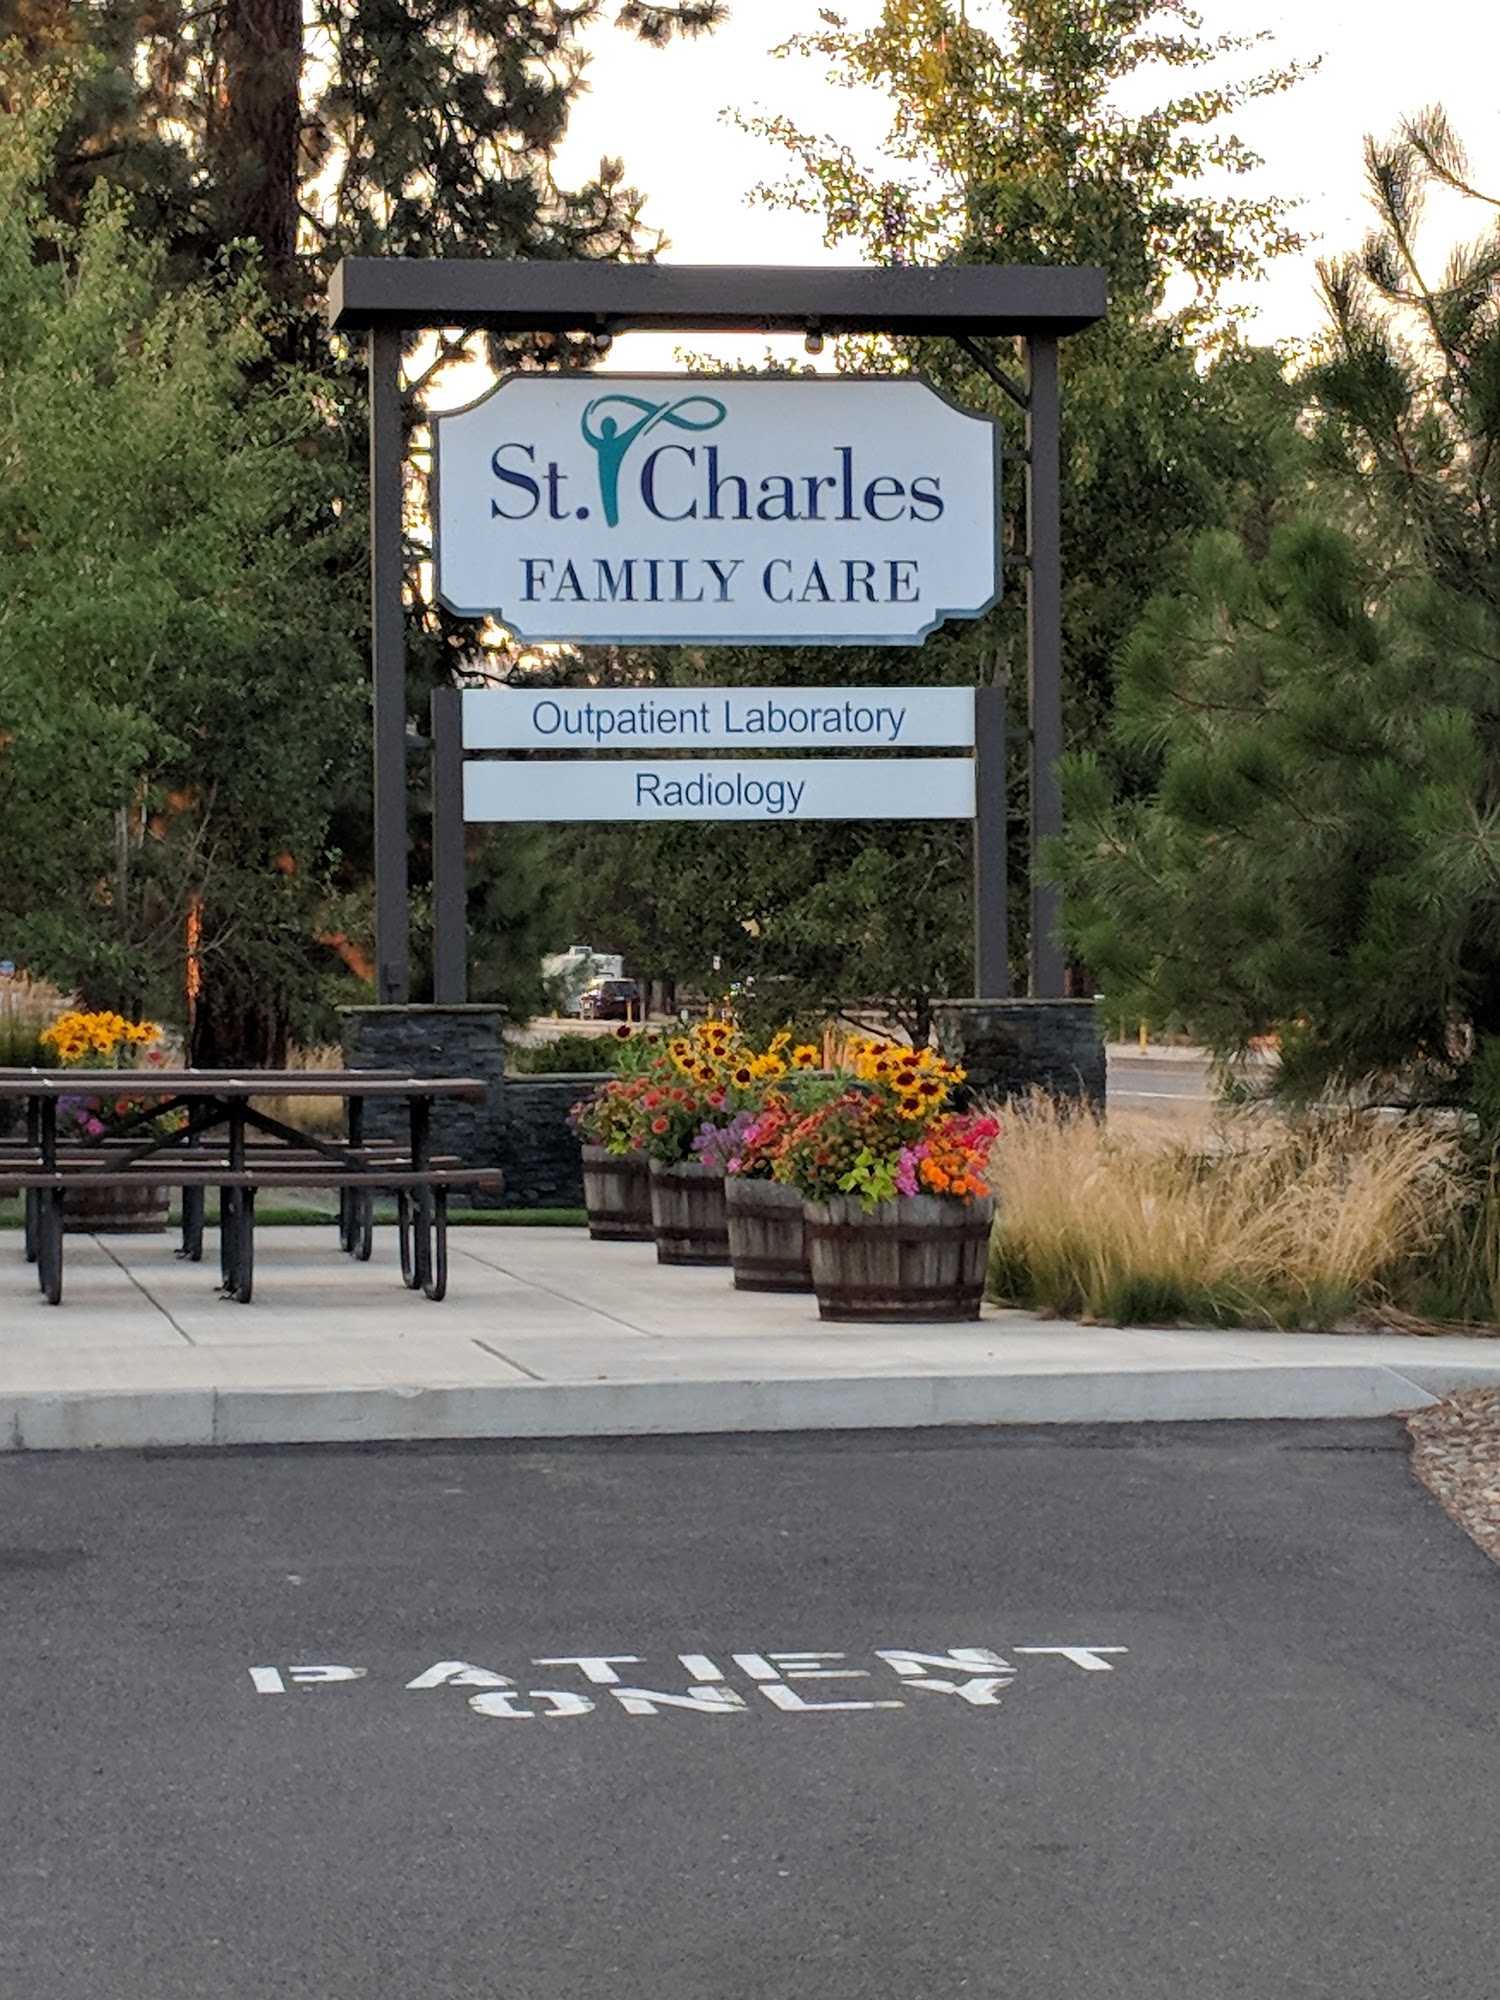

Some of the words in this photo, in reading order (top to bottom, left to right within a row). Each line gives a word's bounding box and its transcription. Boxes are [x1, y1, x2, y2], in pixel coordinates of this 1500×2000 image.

[490, 443, 590, 521] St.
[639, 444, 944, 522] Charles
[519, 558, 744, 602] FAMILY
[763, 559, 920, 602] CARE
[532, 700, 710, 742] Outpatient
[724, 701, 907, 740] Laboratory
[636, 773, 805, 813] Radiology
[247, 1645, 1130, 1695] PATIENT
[467, 1675, 1014, 1720] ONLY
